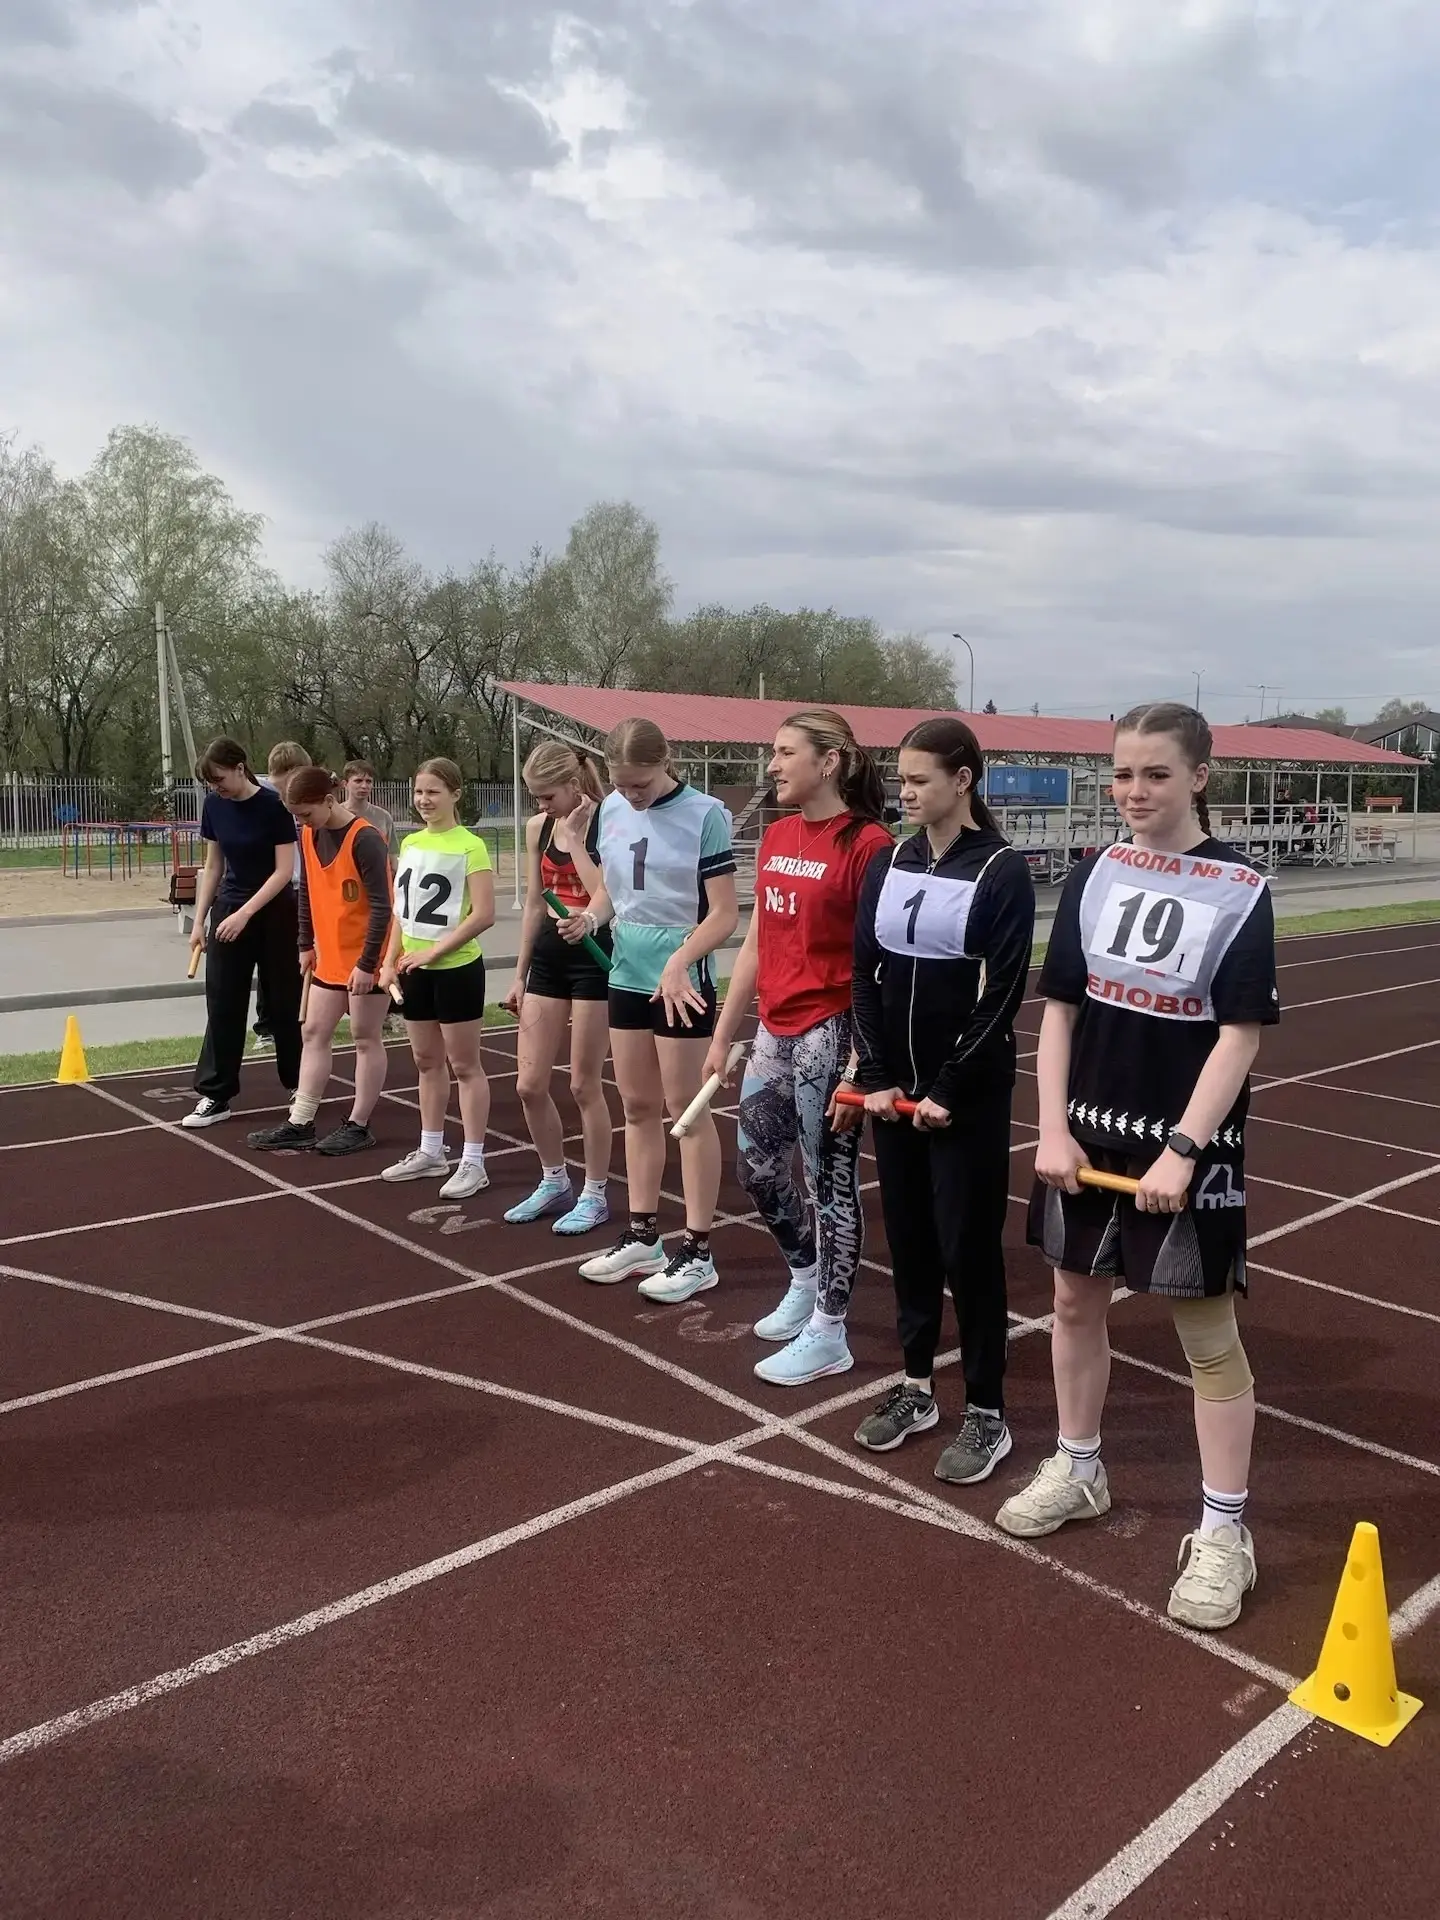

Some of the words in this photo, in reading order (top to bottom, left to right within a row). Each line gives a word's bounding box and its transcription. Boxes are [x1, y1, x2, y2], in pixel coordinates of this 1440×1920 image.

[629, 837, 648, 890] 1
[1230, 867, 1261, 888] 38
[398, 868, 452, 926] 12
[788, 891, 796, 915] 1
[903, 889, 927, 944] 1
[1106, 891, 1184, 963] 19
[1174, 953, 1185, 974] 1
